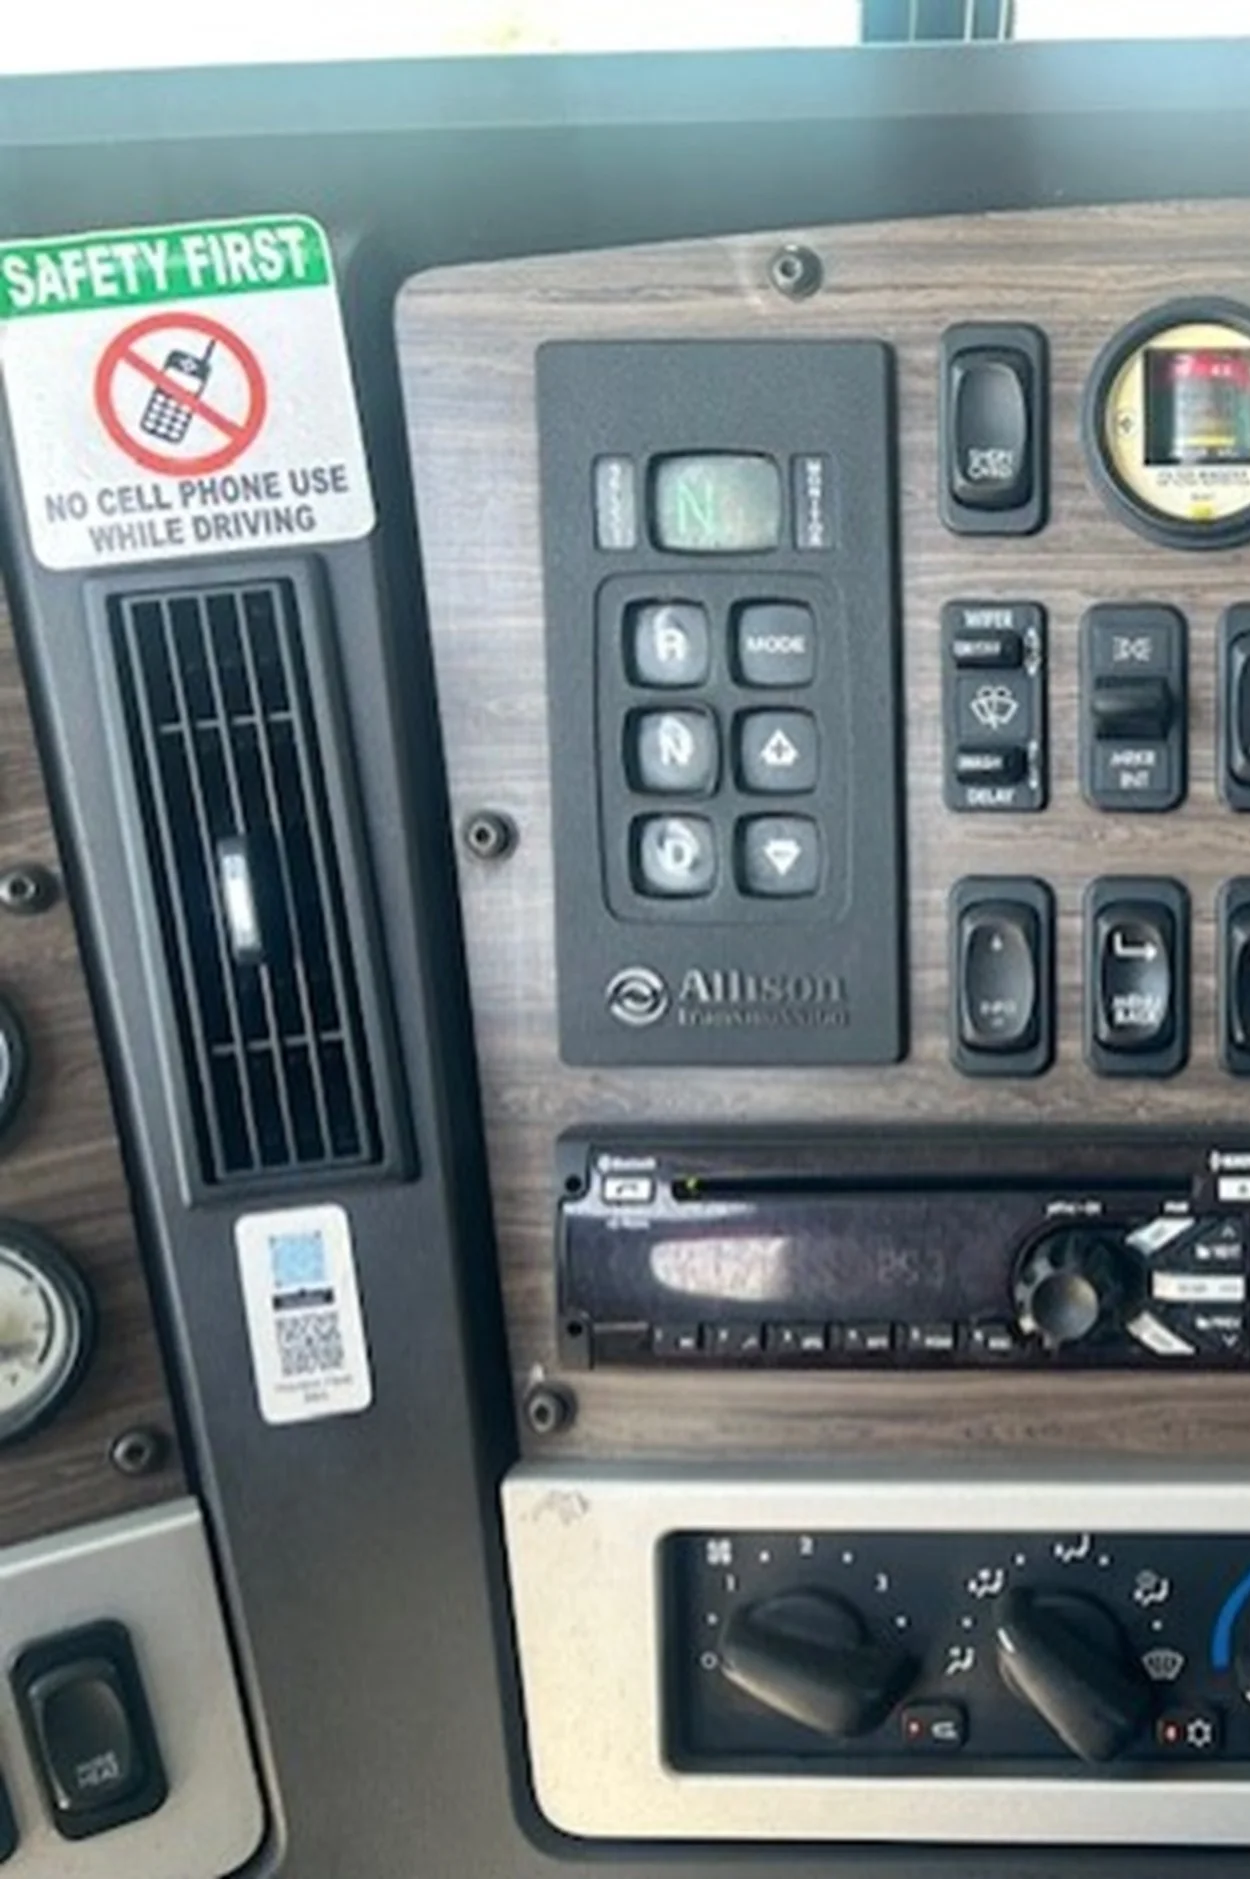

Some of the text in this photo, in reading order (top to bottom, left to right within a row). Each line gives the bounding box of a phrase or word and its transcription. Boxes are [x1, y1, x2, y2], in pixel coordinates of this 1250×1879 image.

[3, 227, 306, 307] SAFETY FIRST
[45, 463, 350, 523] NO CELL PHONE USE
[89, 504, 318, 554] WHILE DRIVING
[963, 609, 1014, 629] WIPER
[745, 636, 806, 655] MODE
[966, 787, 1017, 806] DELAY
[679, 969, 845, 1002] Allison
[800, 1536, 813, 1555] 2
[726, 1573, 735, 1592] 1
[875, 1573, 888, 1592] 3
